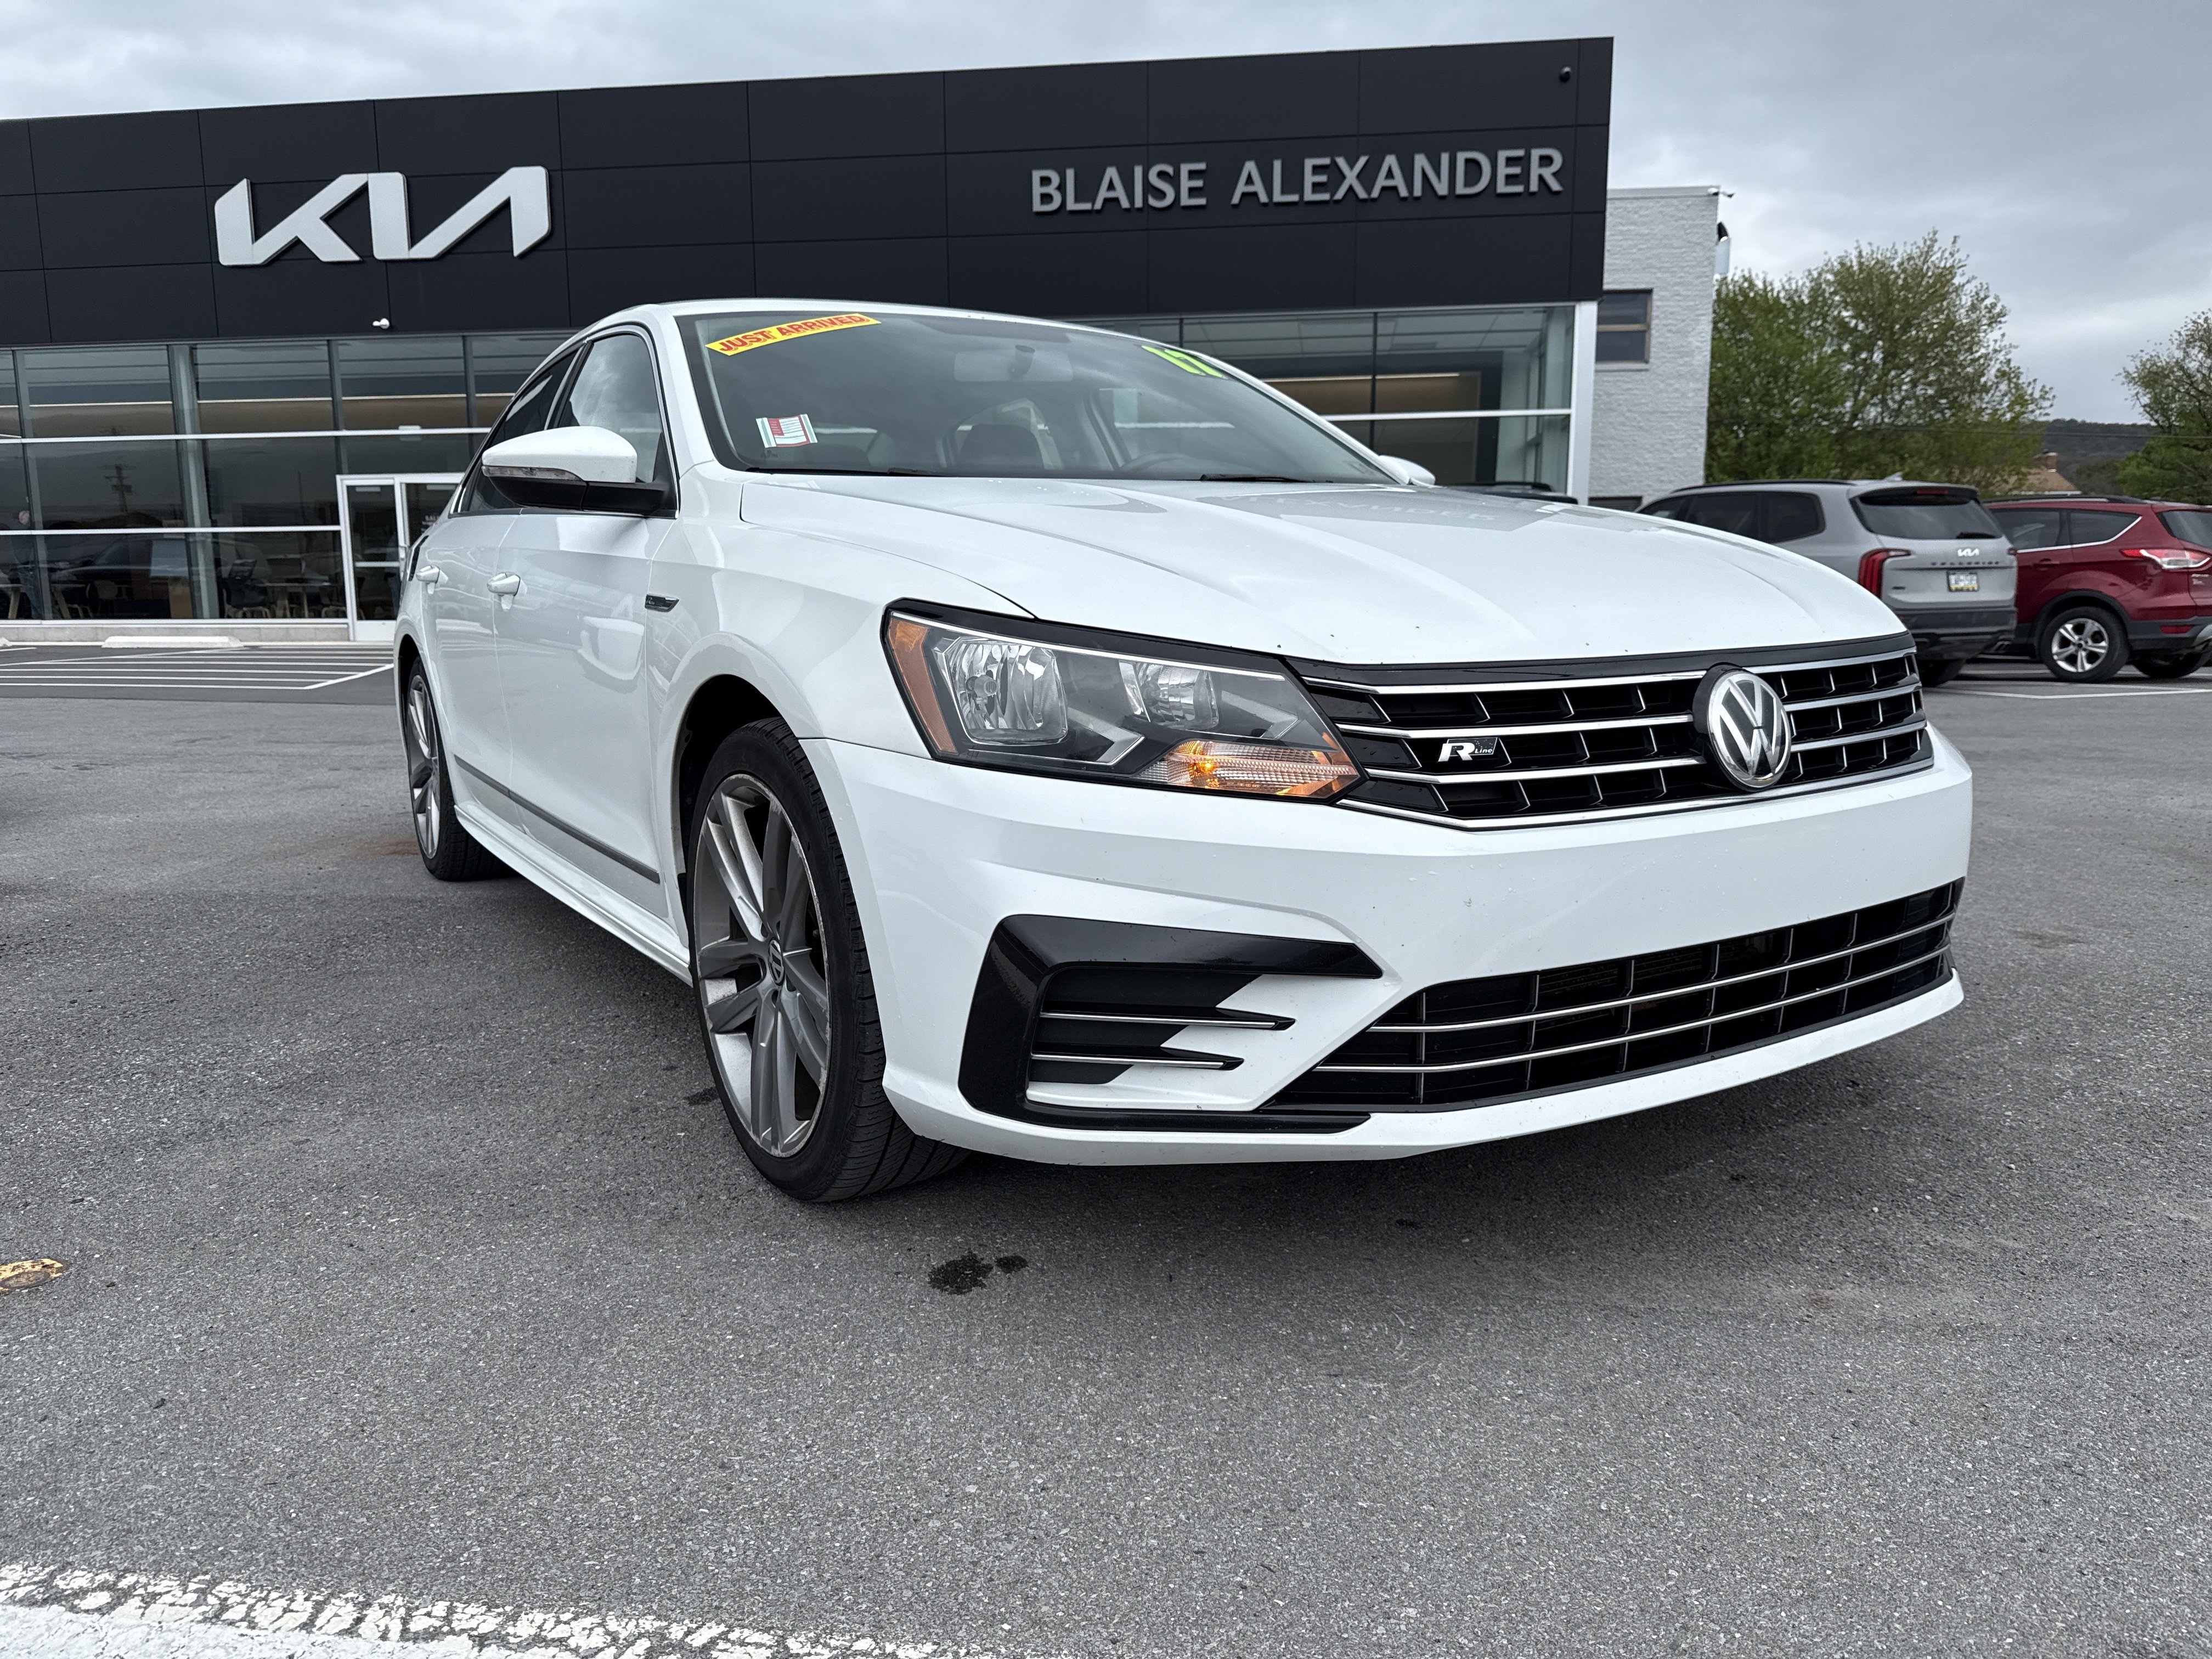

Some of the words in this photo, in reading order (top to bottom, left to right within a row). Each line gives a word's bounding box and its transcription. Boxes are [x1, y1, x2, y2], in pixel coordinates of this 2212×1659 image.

[1032, 162, 1207, 212] BLAISE
[1231, 148, 1563, 205] ALEXANDER
[214, 165, 551, 266] KIA
[719, 330, 776, 352] JUST
[776, 315, 870, 336] ARRIVED
